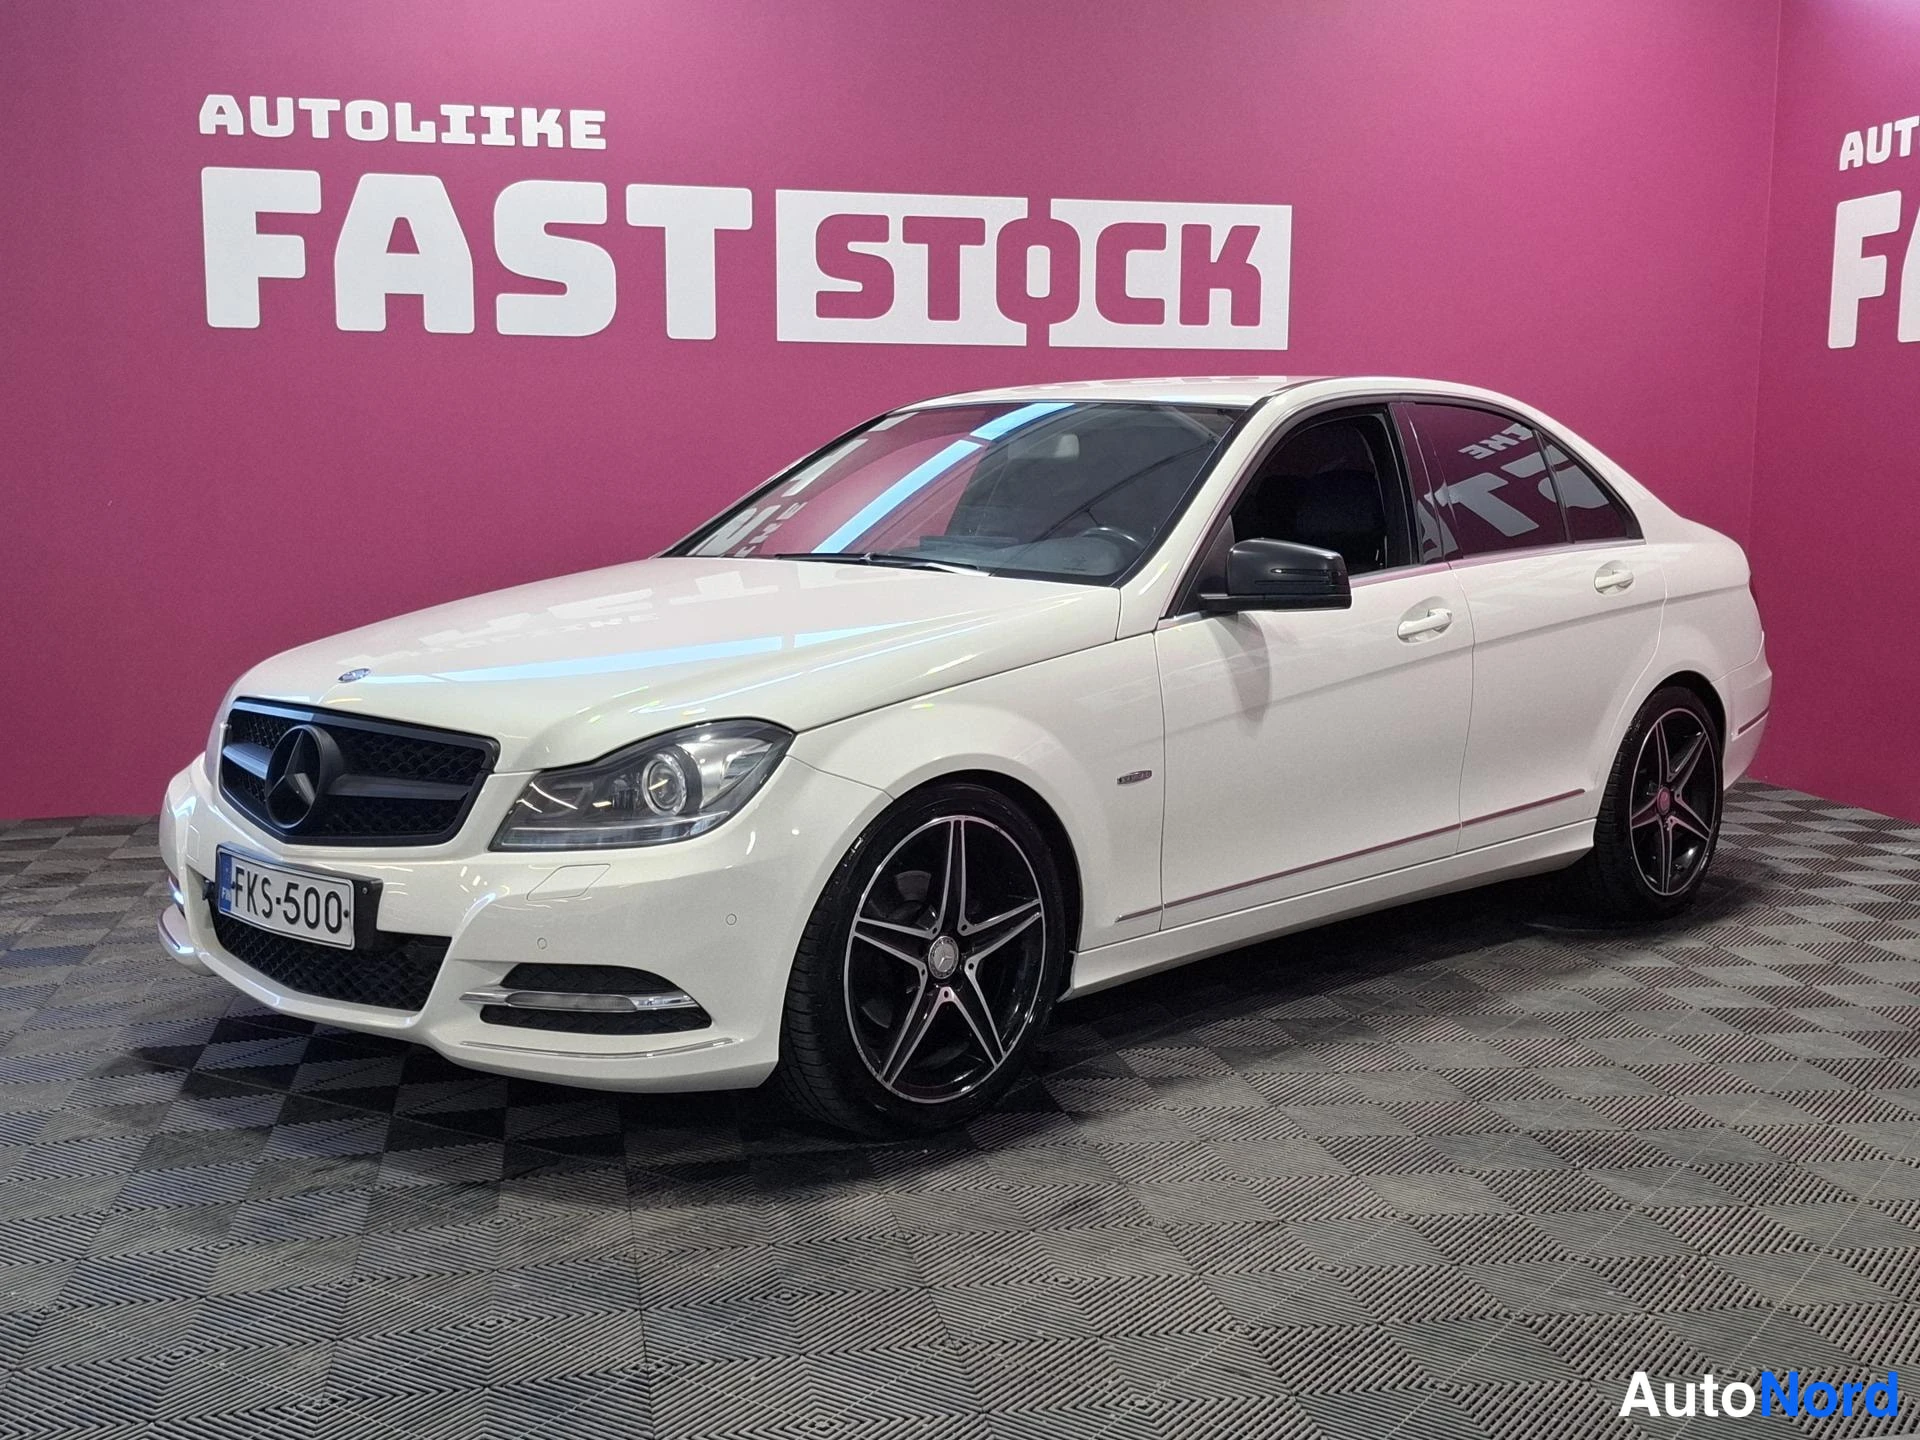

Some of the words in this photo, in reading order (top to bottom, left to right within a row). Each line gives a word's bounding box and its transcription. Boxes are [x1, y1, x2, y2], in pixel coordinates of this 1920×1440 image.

[199, 94, 607, 150] AUTOLIIKE
[201, 166, 753, 340] FAST
[812, 202, 1264, 340] STOCK
